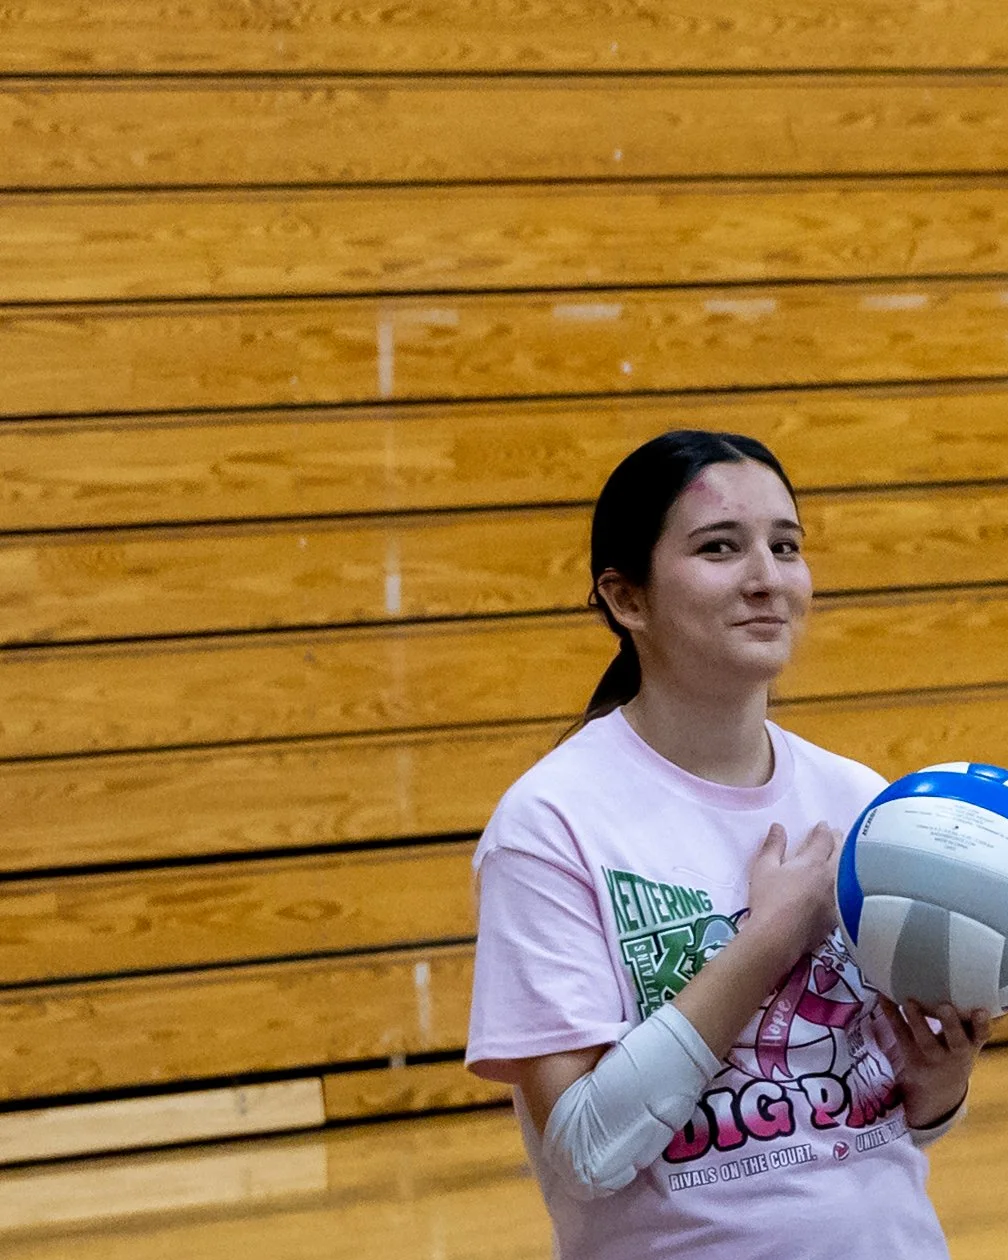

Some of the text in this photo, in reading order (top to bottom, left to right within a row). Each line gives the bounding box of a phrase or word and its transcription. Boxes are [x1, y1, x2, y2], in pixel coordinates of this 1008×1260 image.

[601, 865, 713, 935] KETTERING
[668, 1167, 718, 1192] RIVALS
[719, 1160, 743, 1183] ON
[740, 1153, 769, 1177] THE
[769, 1143, 818, 1170] COURT.
